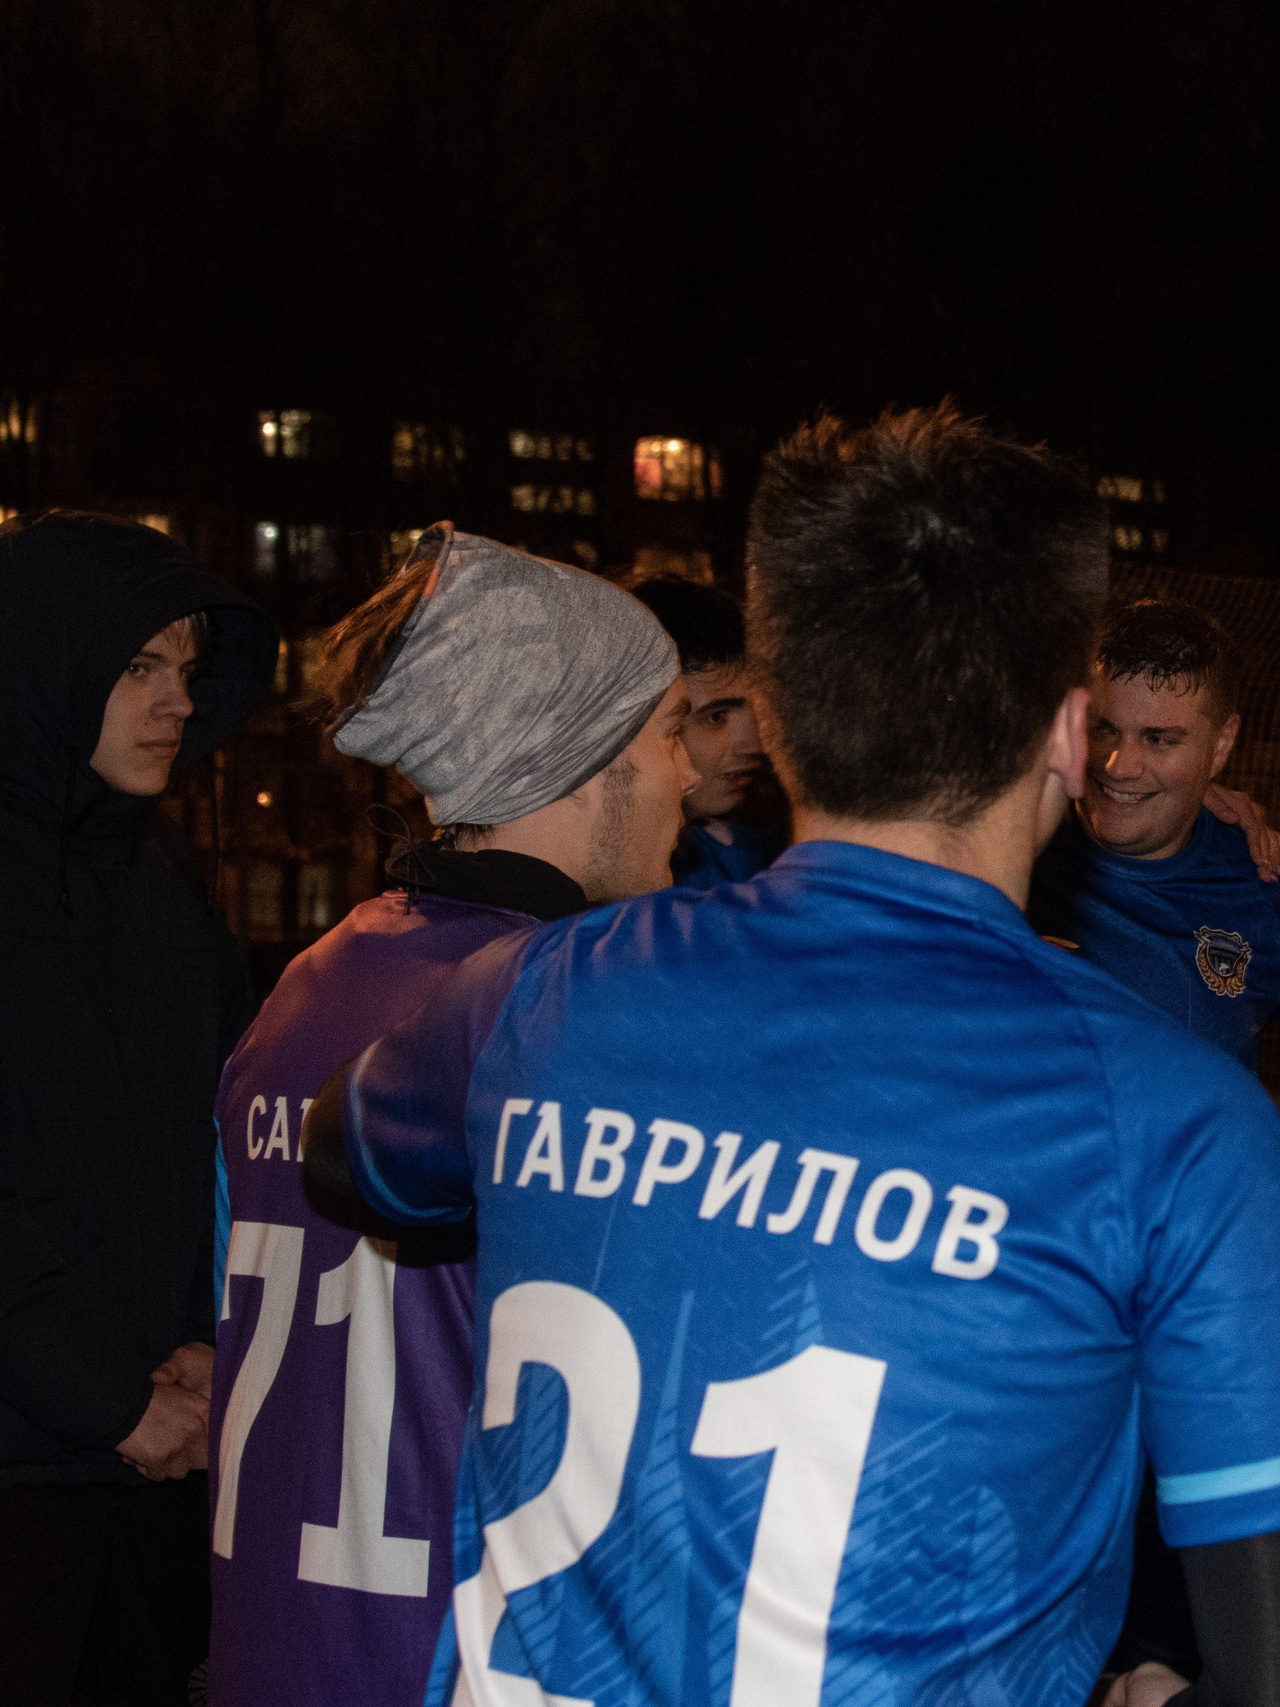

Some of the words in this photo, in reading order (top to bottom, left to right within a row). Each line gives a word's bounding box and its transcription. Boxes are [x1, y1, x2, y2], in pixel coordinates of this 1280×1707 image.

[492, 1098, 1010, 1281] ГАВРИЛОВ
[213, 1221, 432, 1598] 71
[450, 1279, 888, 1707] 21
